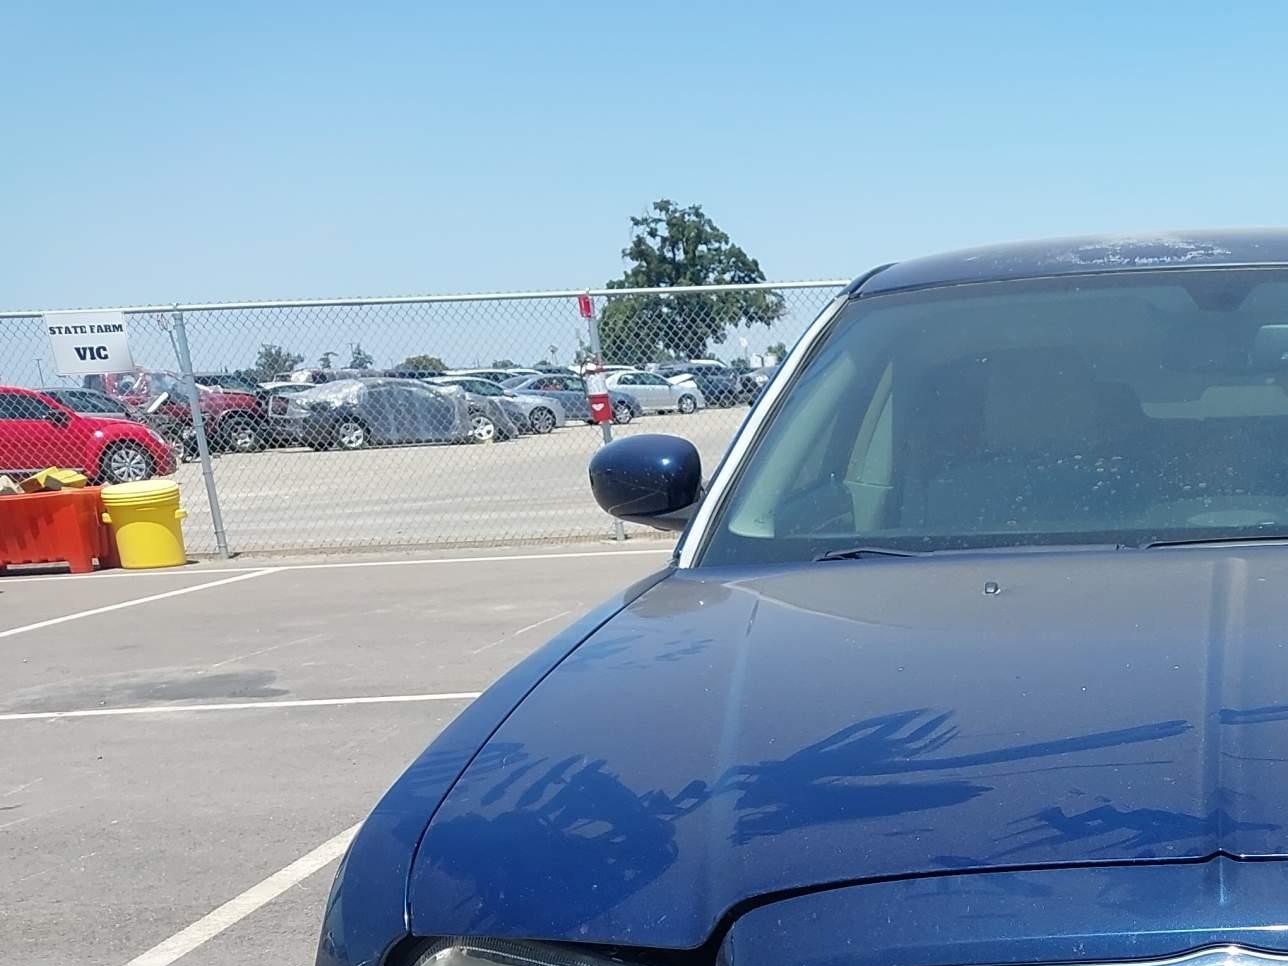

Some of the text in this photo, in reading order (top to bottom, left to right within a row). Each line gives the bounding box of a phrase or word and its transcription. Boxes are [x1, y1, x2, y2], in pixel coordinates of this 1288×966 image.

[48, 324, 123, 335] STATE FARM
[74, 346, 108, 360] VIC
